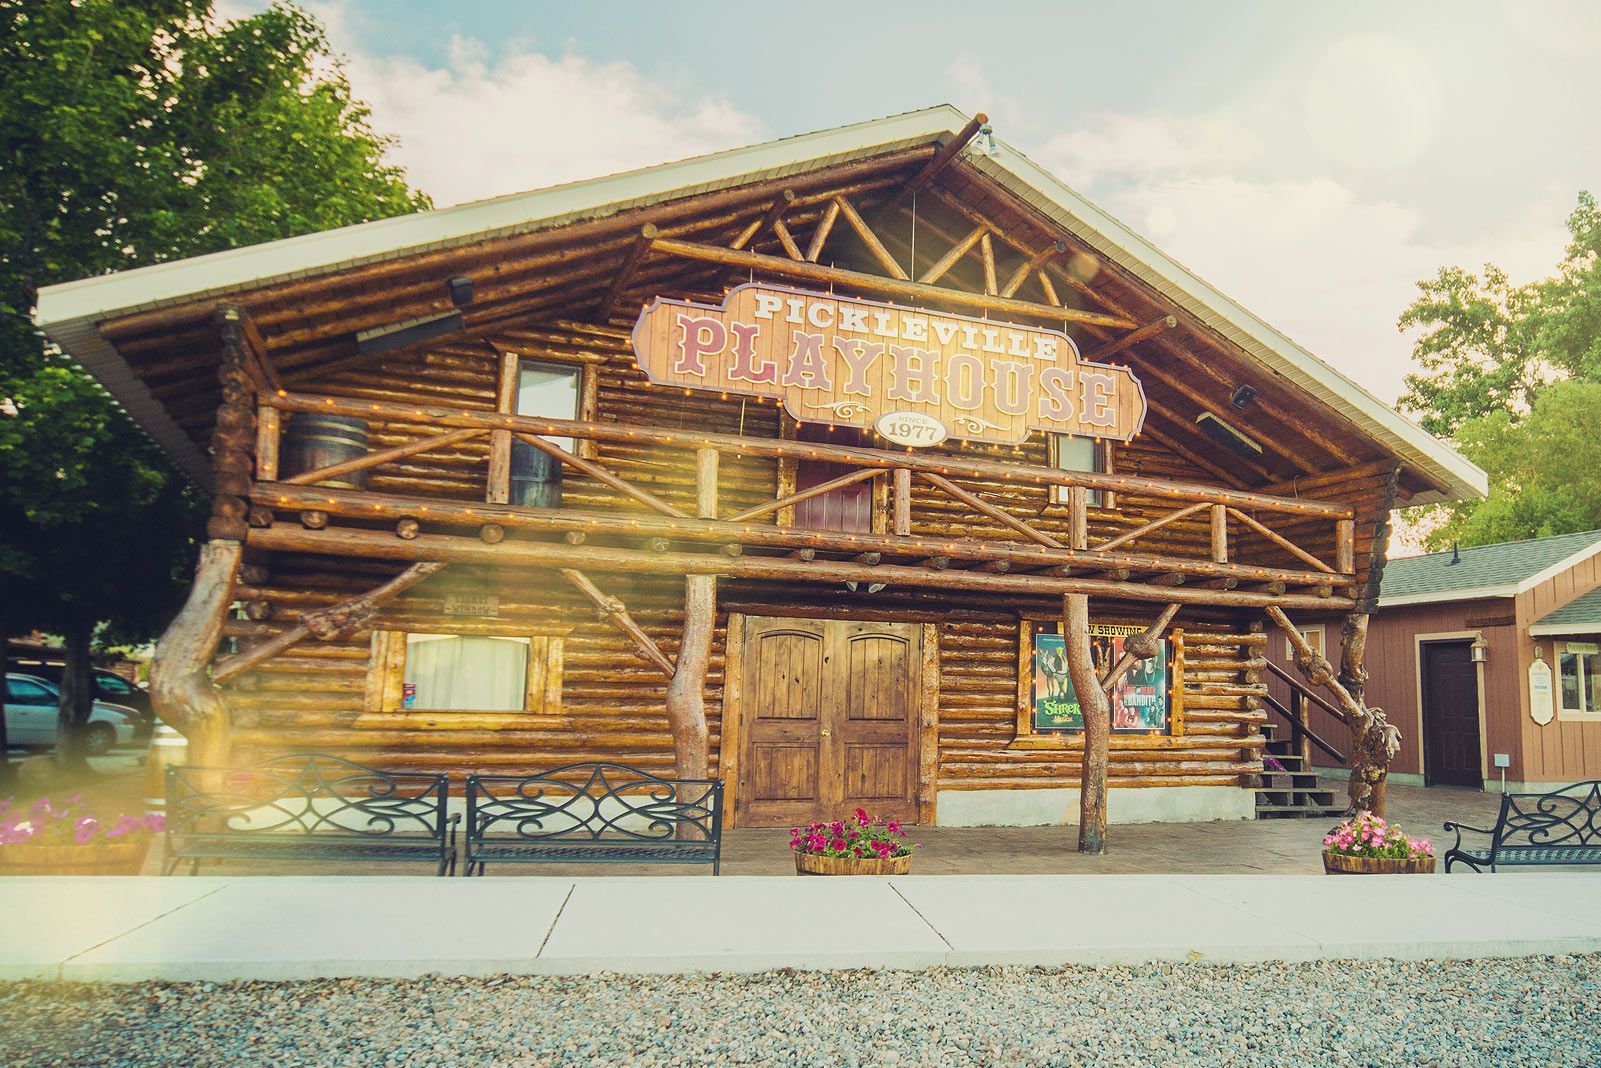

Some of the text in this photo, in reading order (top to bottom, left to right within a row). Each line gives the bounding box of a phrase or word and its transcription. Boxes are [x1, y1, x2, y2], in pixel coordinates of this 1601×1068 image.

[755, 293, 1058, 361] PICKLEVILLE
[675, 313, 1117, 427] PLAYHOUSE
[888, 422, 937, 440] 1977
[898, 416, 928, 425] SINCE
